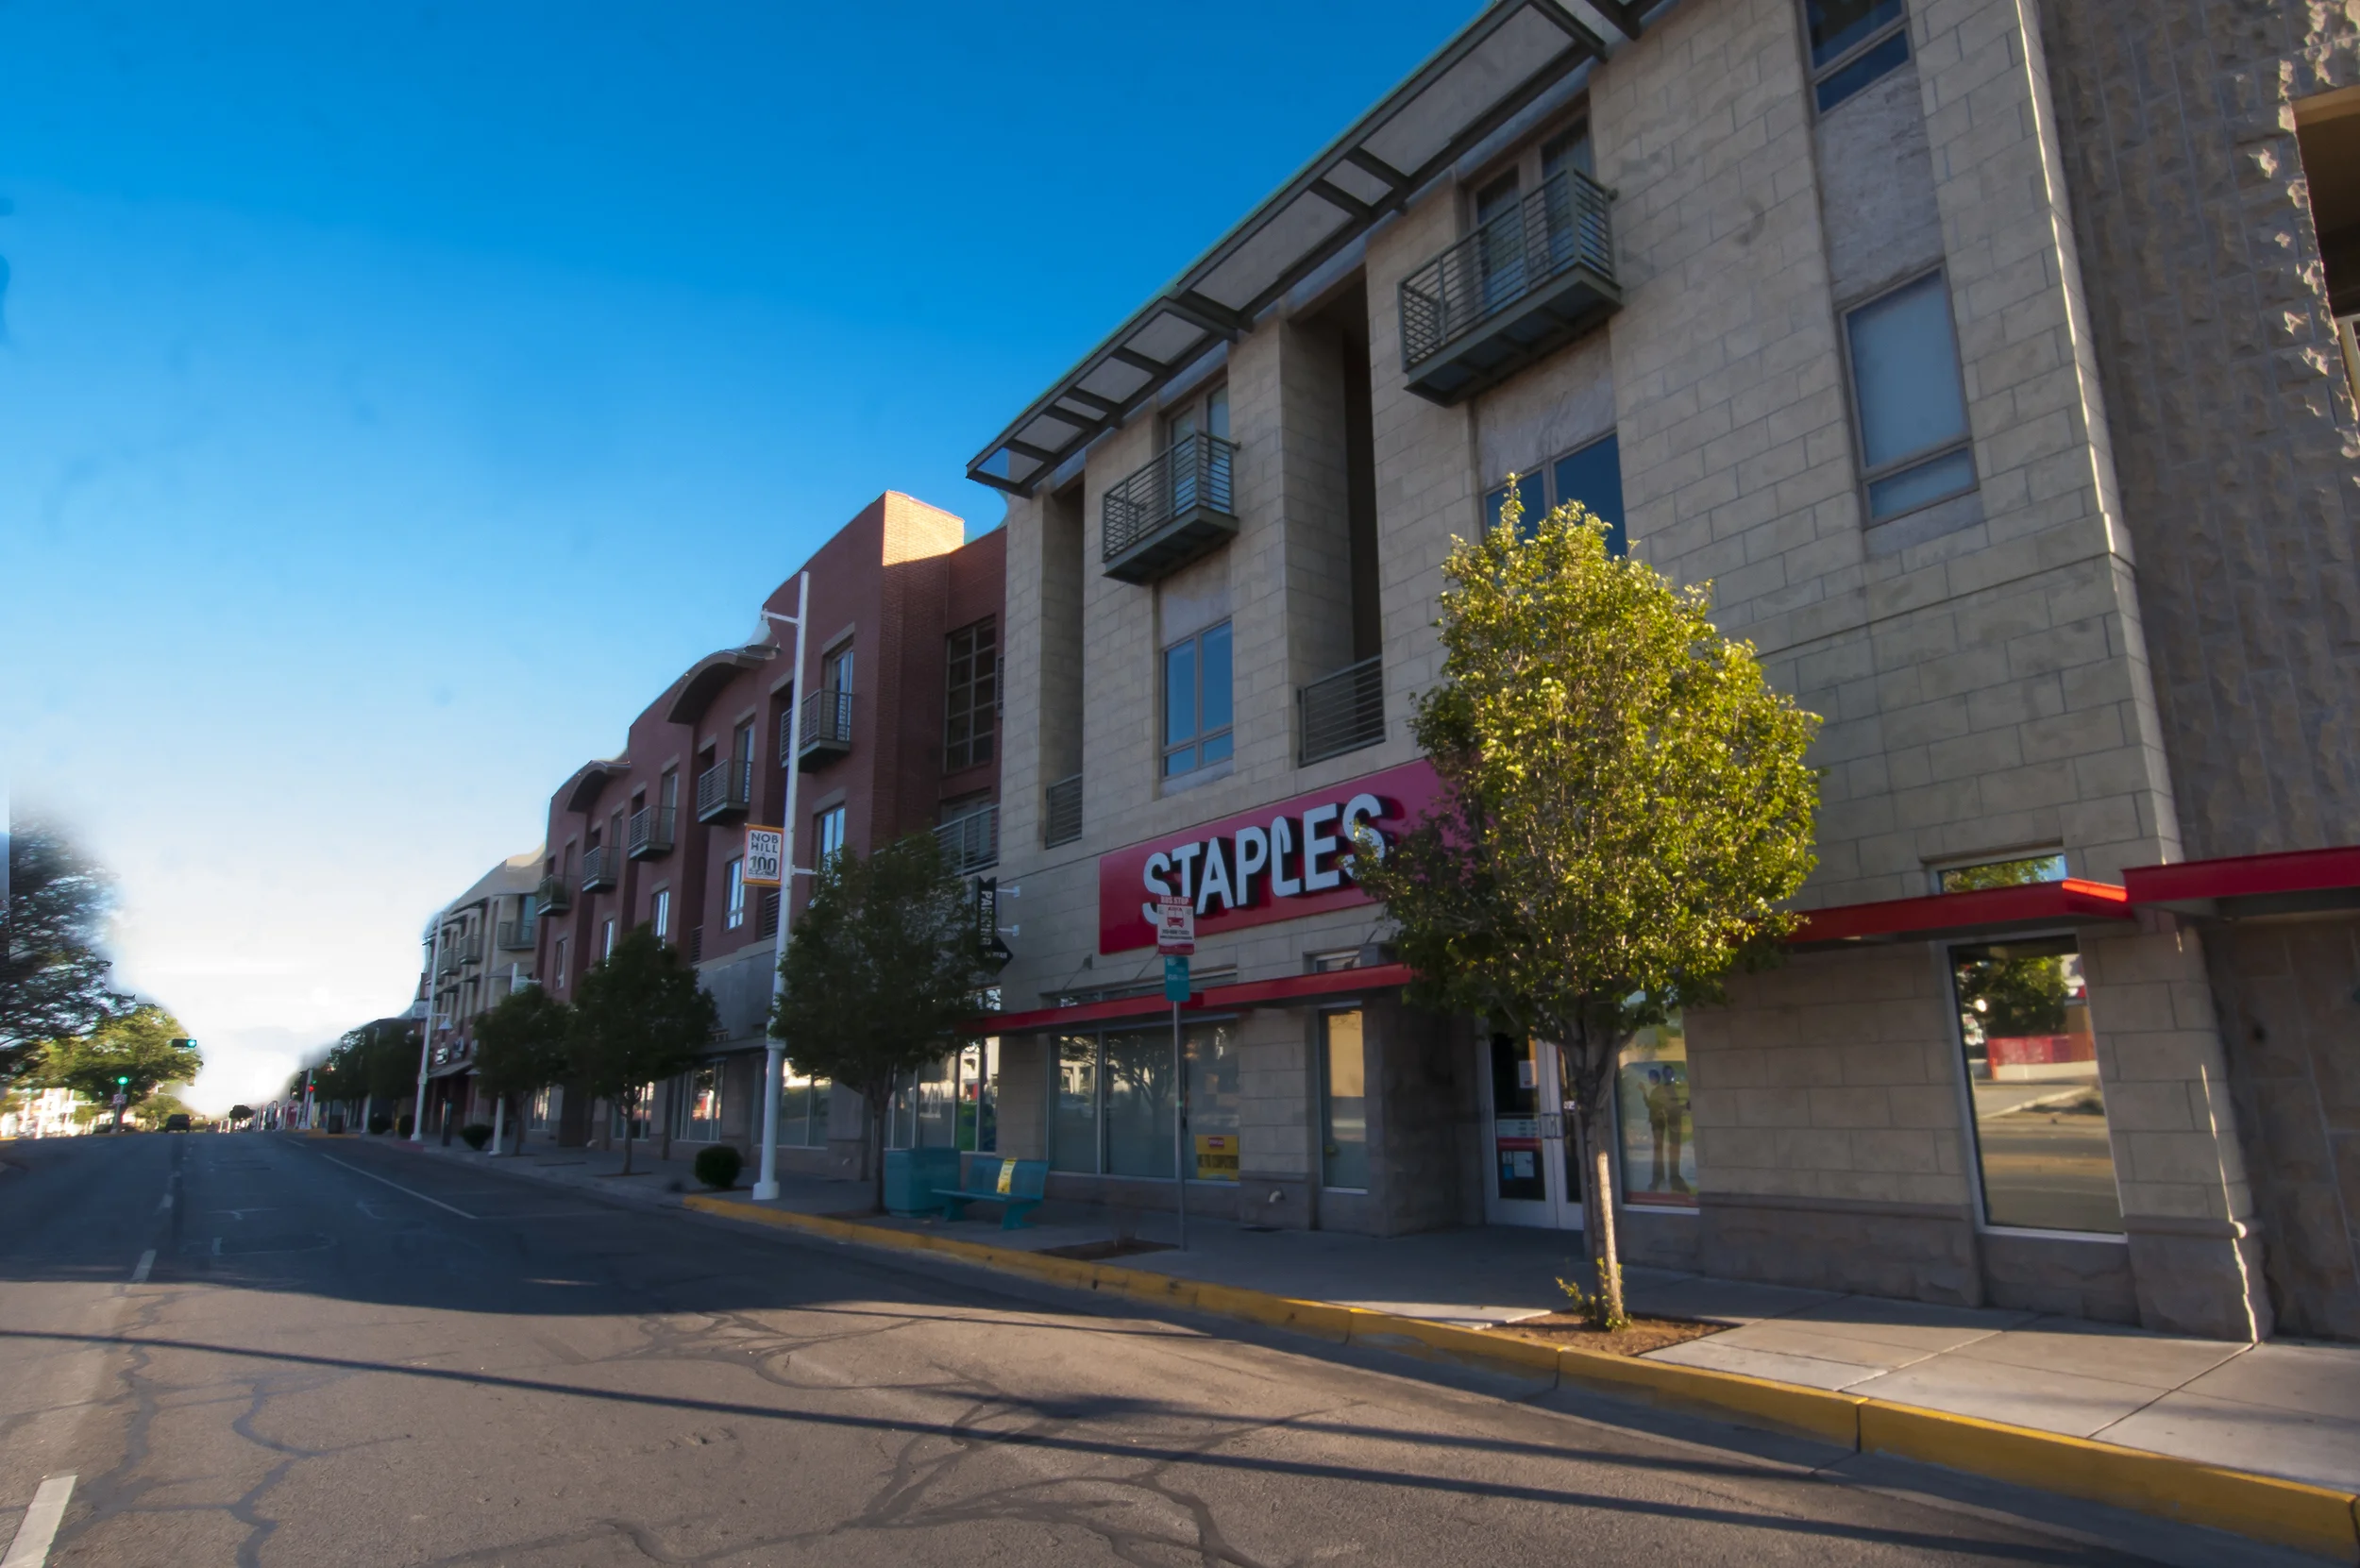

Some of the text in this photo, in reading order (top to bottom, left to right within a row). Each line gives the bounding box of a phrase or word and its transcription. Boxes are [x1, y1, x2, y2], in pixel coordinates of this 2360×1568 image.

[751, 833, 779, 843] NOB
[750, 842, 778, 853] HILL
[750, 855, 777, 873] 100
[1142, 793, 1387, 925] STAPLES
